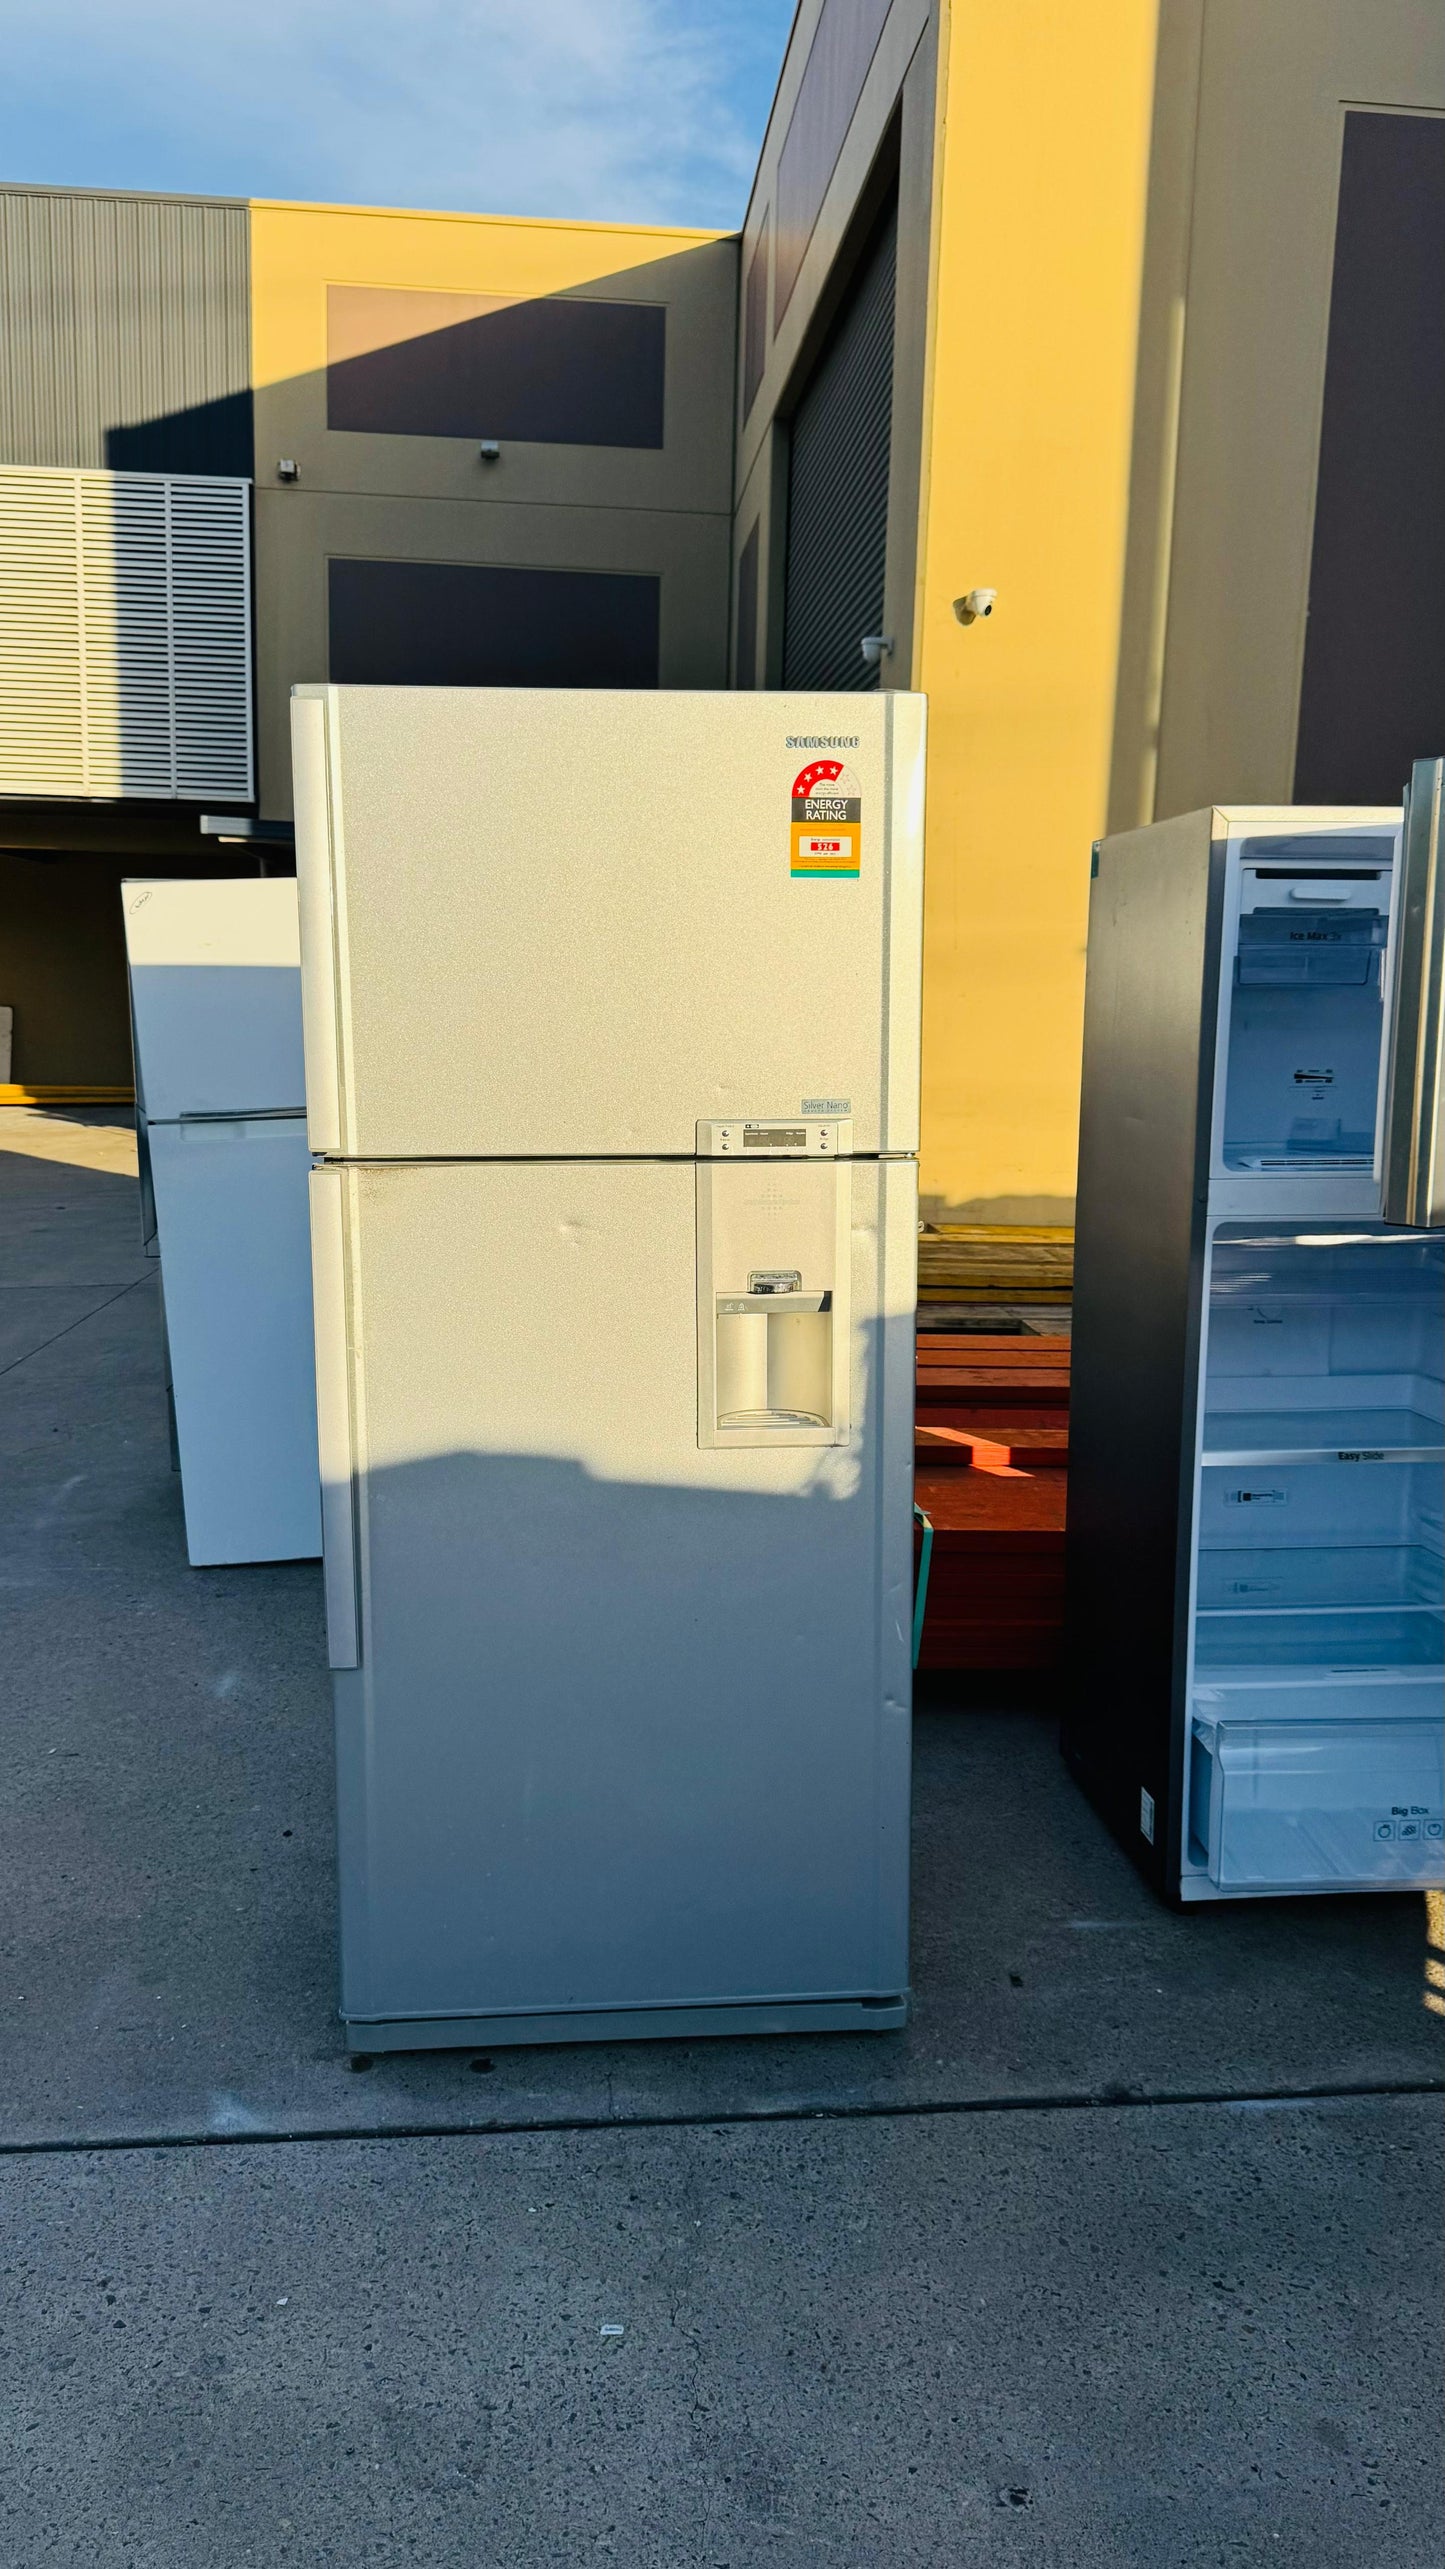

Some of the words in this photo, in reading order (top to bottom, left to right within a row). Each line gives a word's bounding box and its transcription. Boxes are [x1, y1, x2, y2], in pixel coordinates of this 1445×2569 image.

[785, 735, 860, 748] SAMSUNG
[805, 799, 848, 810] ENERGY
[806, 810, 847, 820] RATING
[817, 842, 834, 851] 526
[803, 1100, 824, 1110] Silver
[826, 1101, 848, 1109] Nano
[1338, 1451, 1360, 1462] Easy
[1391, 1806, 1408, 1817] Big
[1410, 1805, 1429, 1815] Box
